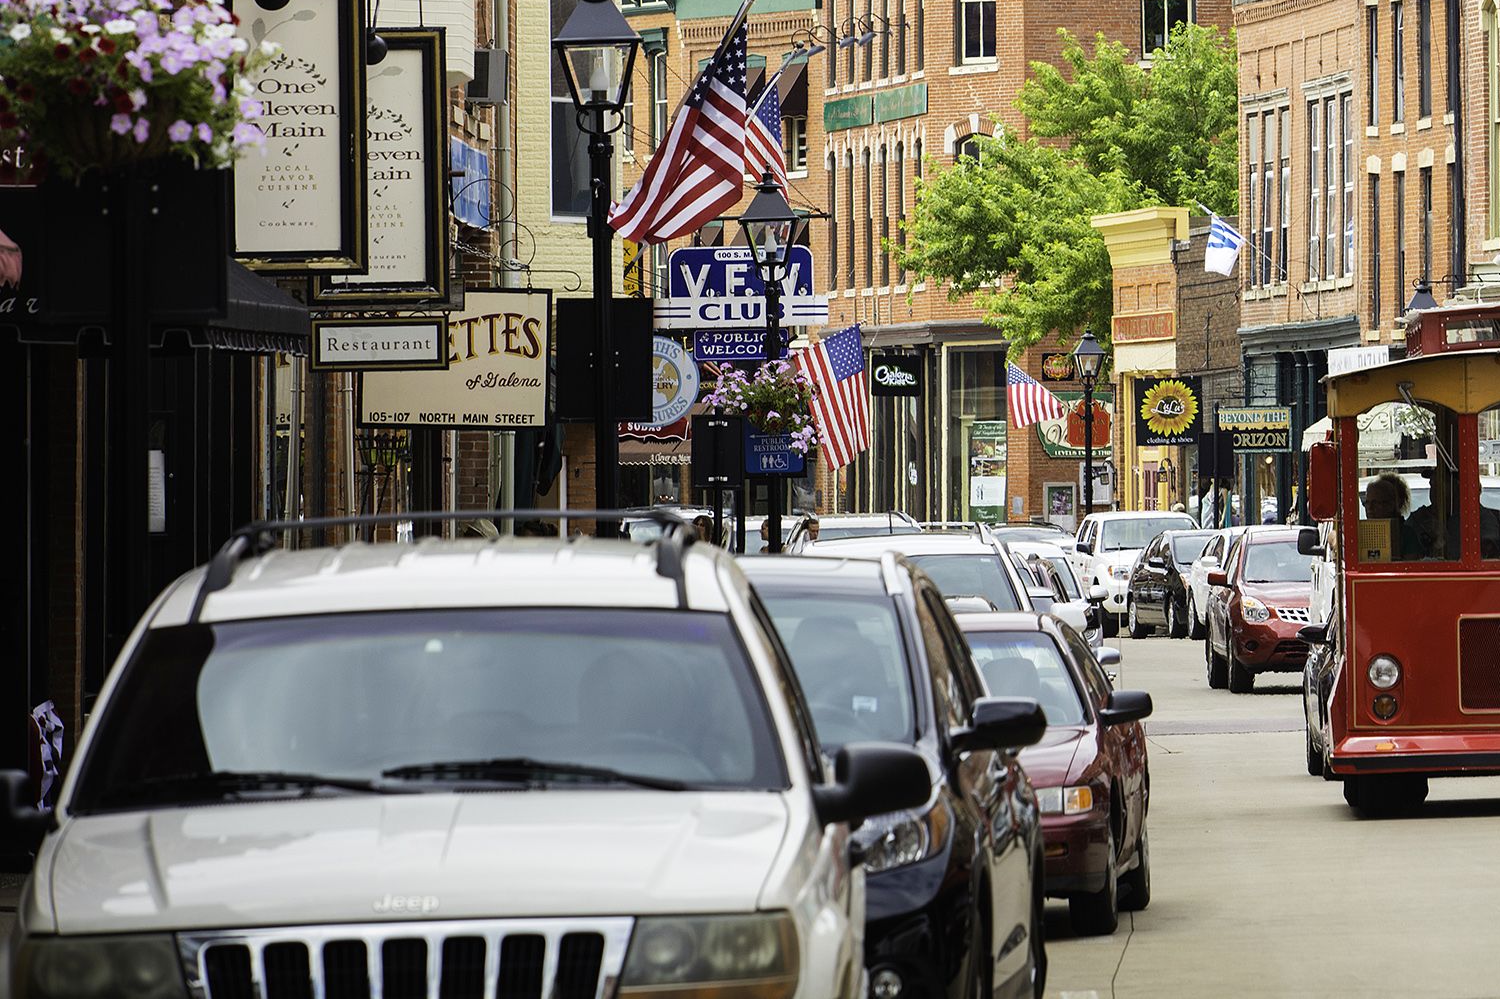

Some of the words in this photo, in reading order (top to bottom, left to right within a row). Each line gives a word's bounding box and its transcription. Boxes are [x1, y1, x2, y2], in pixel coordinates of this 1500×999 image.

[257, 78, 317, 94] One
[250, 121, 327, 138] Main
[367, 129, 402, 141] ne
[367, 150, 422, 161] even
[261, 174, 315, 182] FLAVOR
[367, 166, 412, 181] ain
[257, 183, 318, 191] CUISINE
[258, 219, 315, 227] Cookware
[743, 251, 764, 259] MN
[327, 336, 432, 352] Restaurant
[702, 344, 763, 356] WELCO
[465, 372, 481, 390] of
[480, 371, 542, 388] Galena
[1151, 399, 1186, 414] LuLu's
[368, 412, 411, 422] 105-107
[419, 412, 456, 423] NORTH
[462, 413, 489, 423] MAIN
[494, 414, 536, 424] STREET
[1218, 412, 1263, 424] BEYOND
[1263, 411, 1287, 422] THE
[1146, 437, 1170, 445] clothing
[1233, 432, 1288, 448] ORIZON
[371, 893, 440, 914] Jeep
